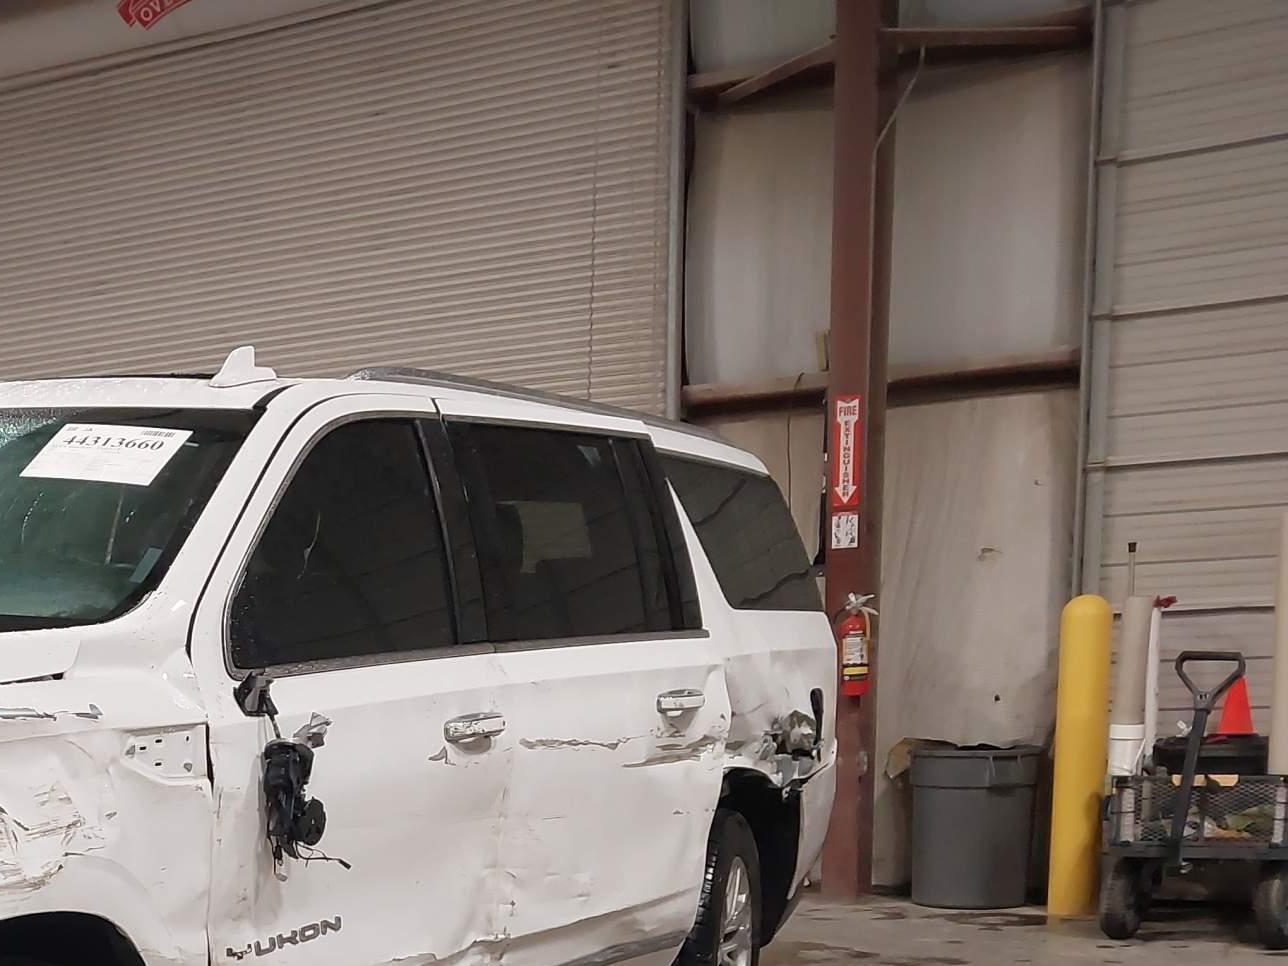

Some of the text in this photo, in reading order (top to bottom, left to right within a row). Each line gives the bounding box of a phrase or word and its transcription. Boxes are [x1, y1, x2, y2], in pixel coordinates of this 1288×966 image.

[838, 405, 858, 417] FIRE
[63, 434, 165, 451] 44313660
[841, 420, 851, 498] EXTINGUISHER
